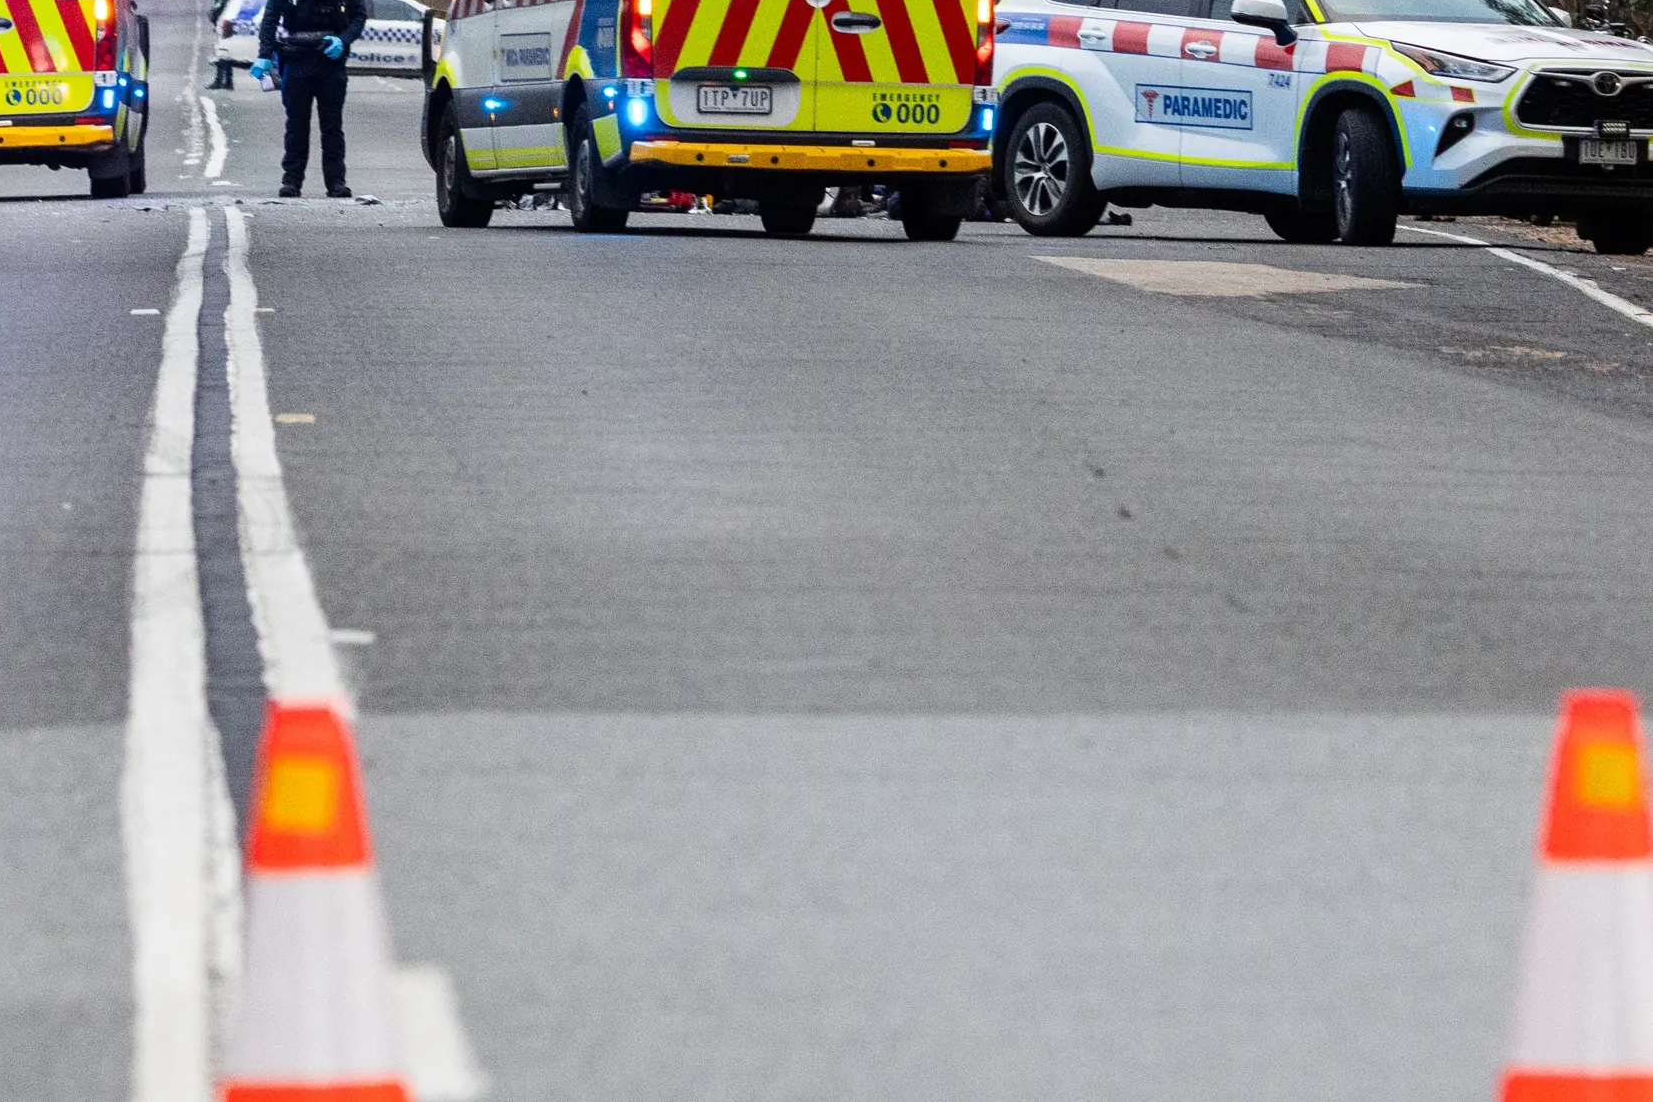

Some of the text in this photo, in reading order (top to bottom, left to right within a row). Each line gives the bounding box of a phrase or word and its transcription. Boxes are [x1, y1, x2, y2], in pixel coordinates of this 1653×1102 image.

[1268, 73, 1291, 88] 7424
[26, 89, 63, 105] 000
[703, 90, 768, 106] 1TP 7UP
[872, 92, 940, 102] EMERGENCY
[897, 103, 940, 124] 000
[1163, 94, 1248, 121] PARAMEDIC
